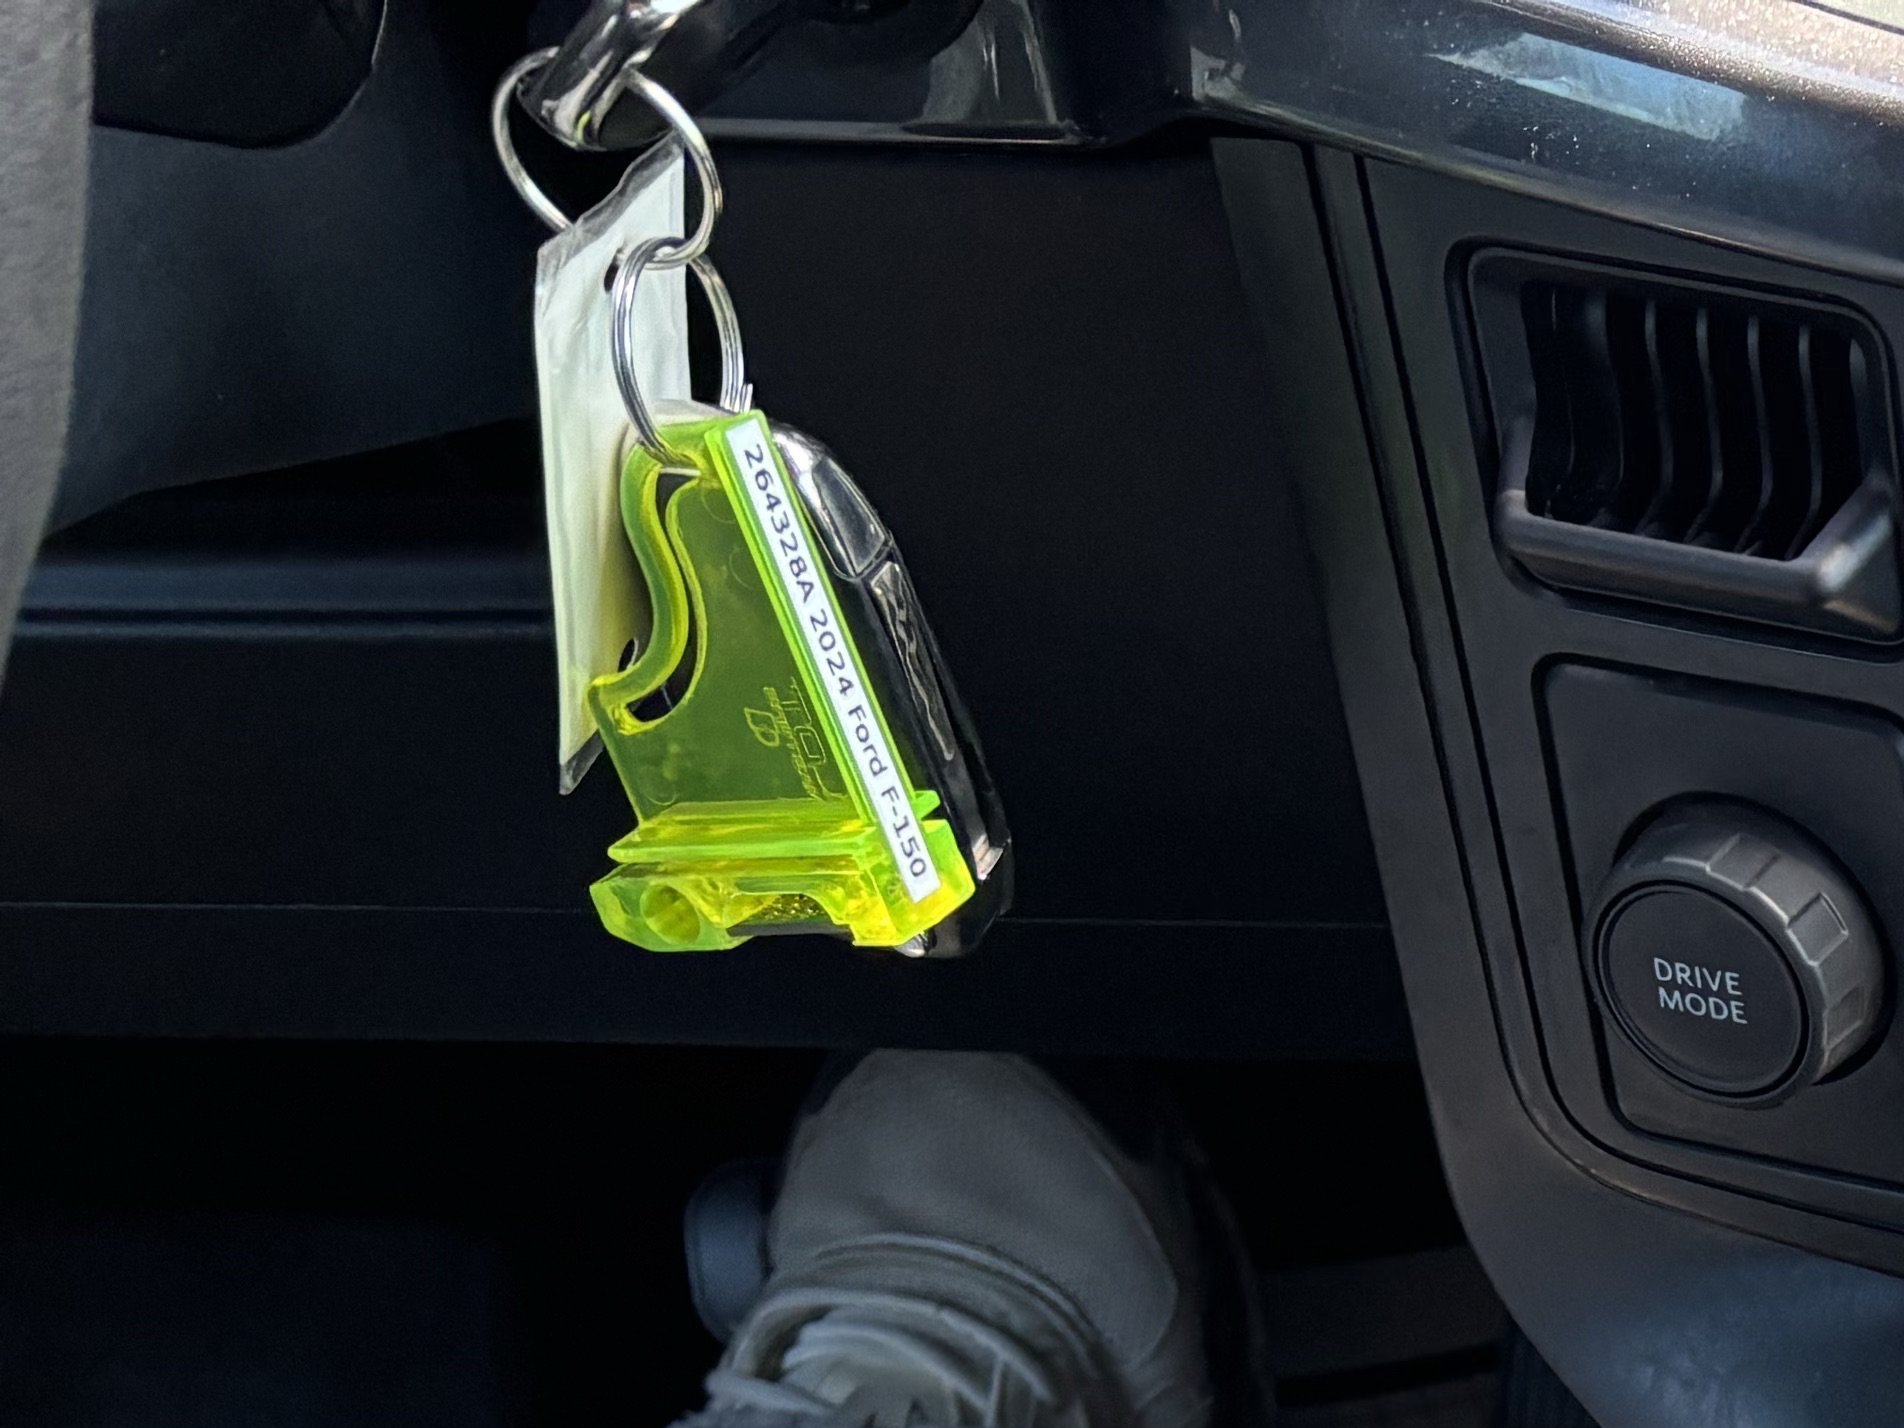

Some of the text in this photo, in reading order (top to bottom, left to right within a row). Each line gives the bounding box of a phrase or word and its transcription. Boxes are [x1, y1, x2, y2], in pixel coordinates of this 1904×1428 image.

[743, 443, 927, 879] 264328A 2024 Ford F-150
[1653, 956, 1743, 996] DRIVE
[1658, 986, 1748, 1025] MODE
